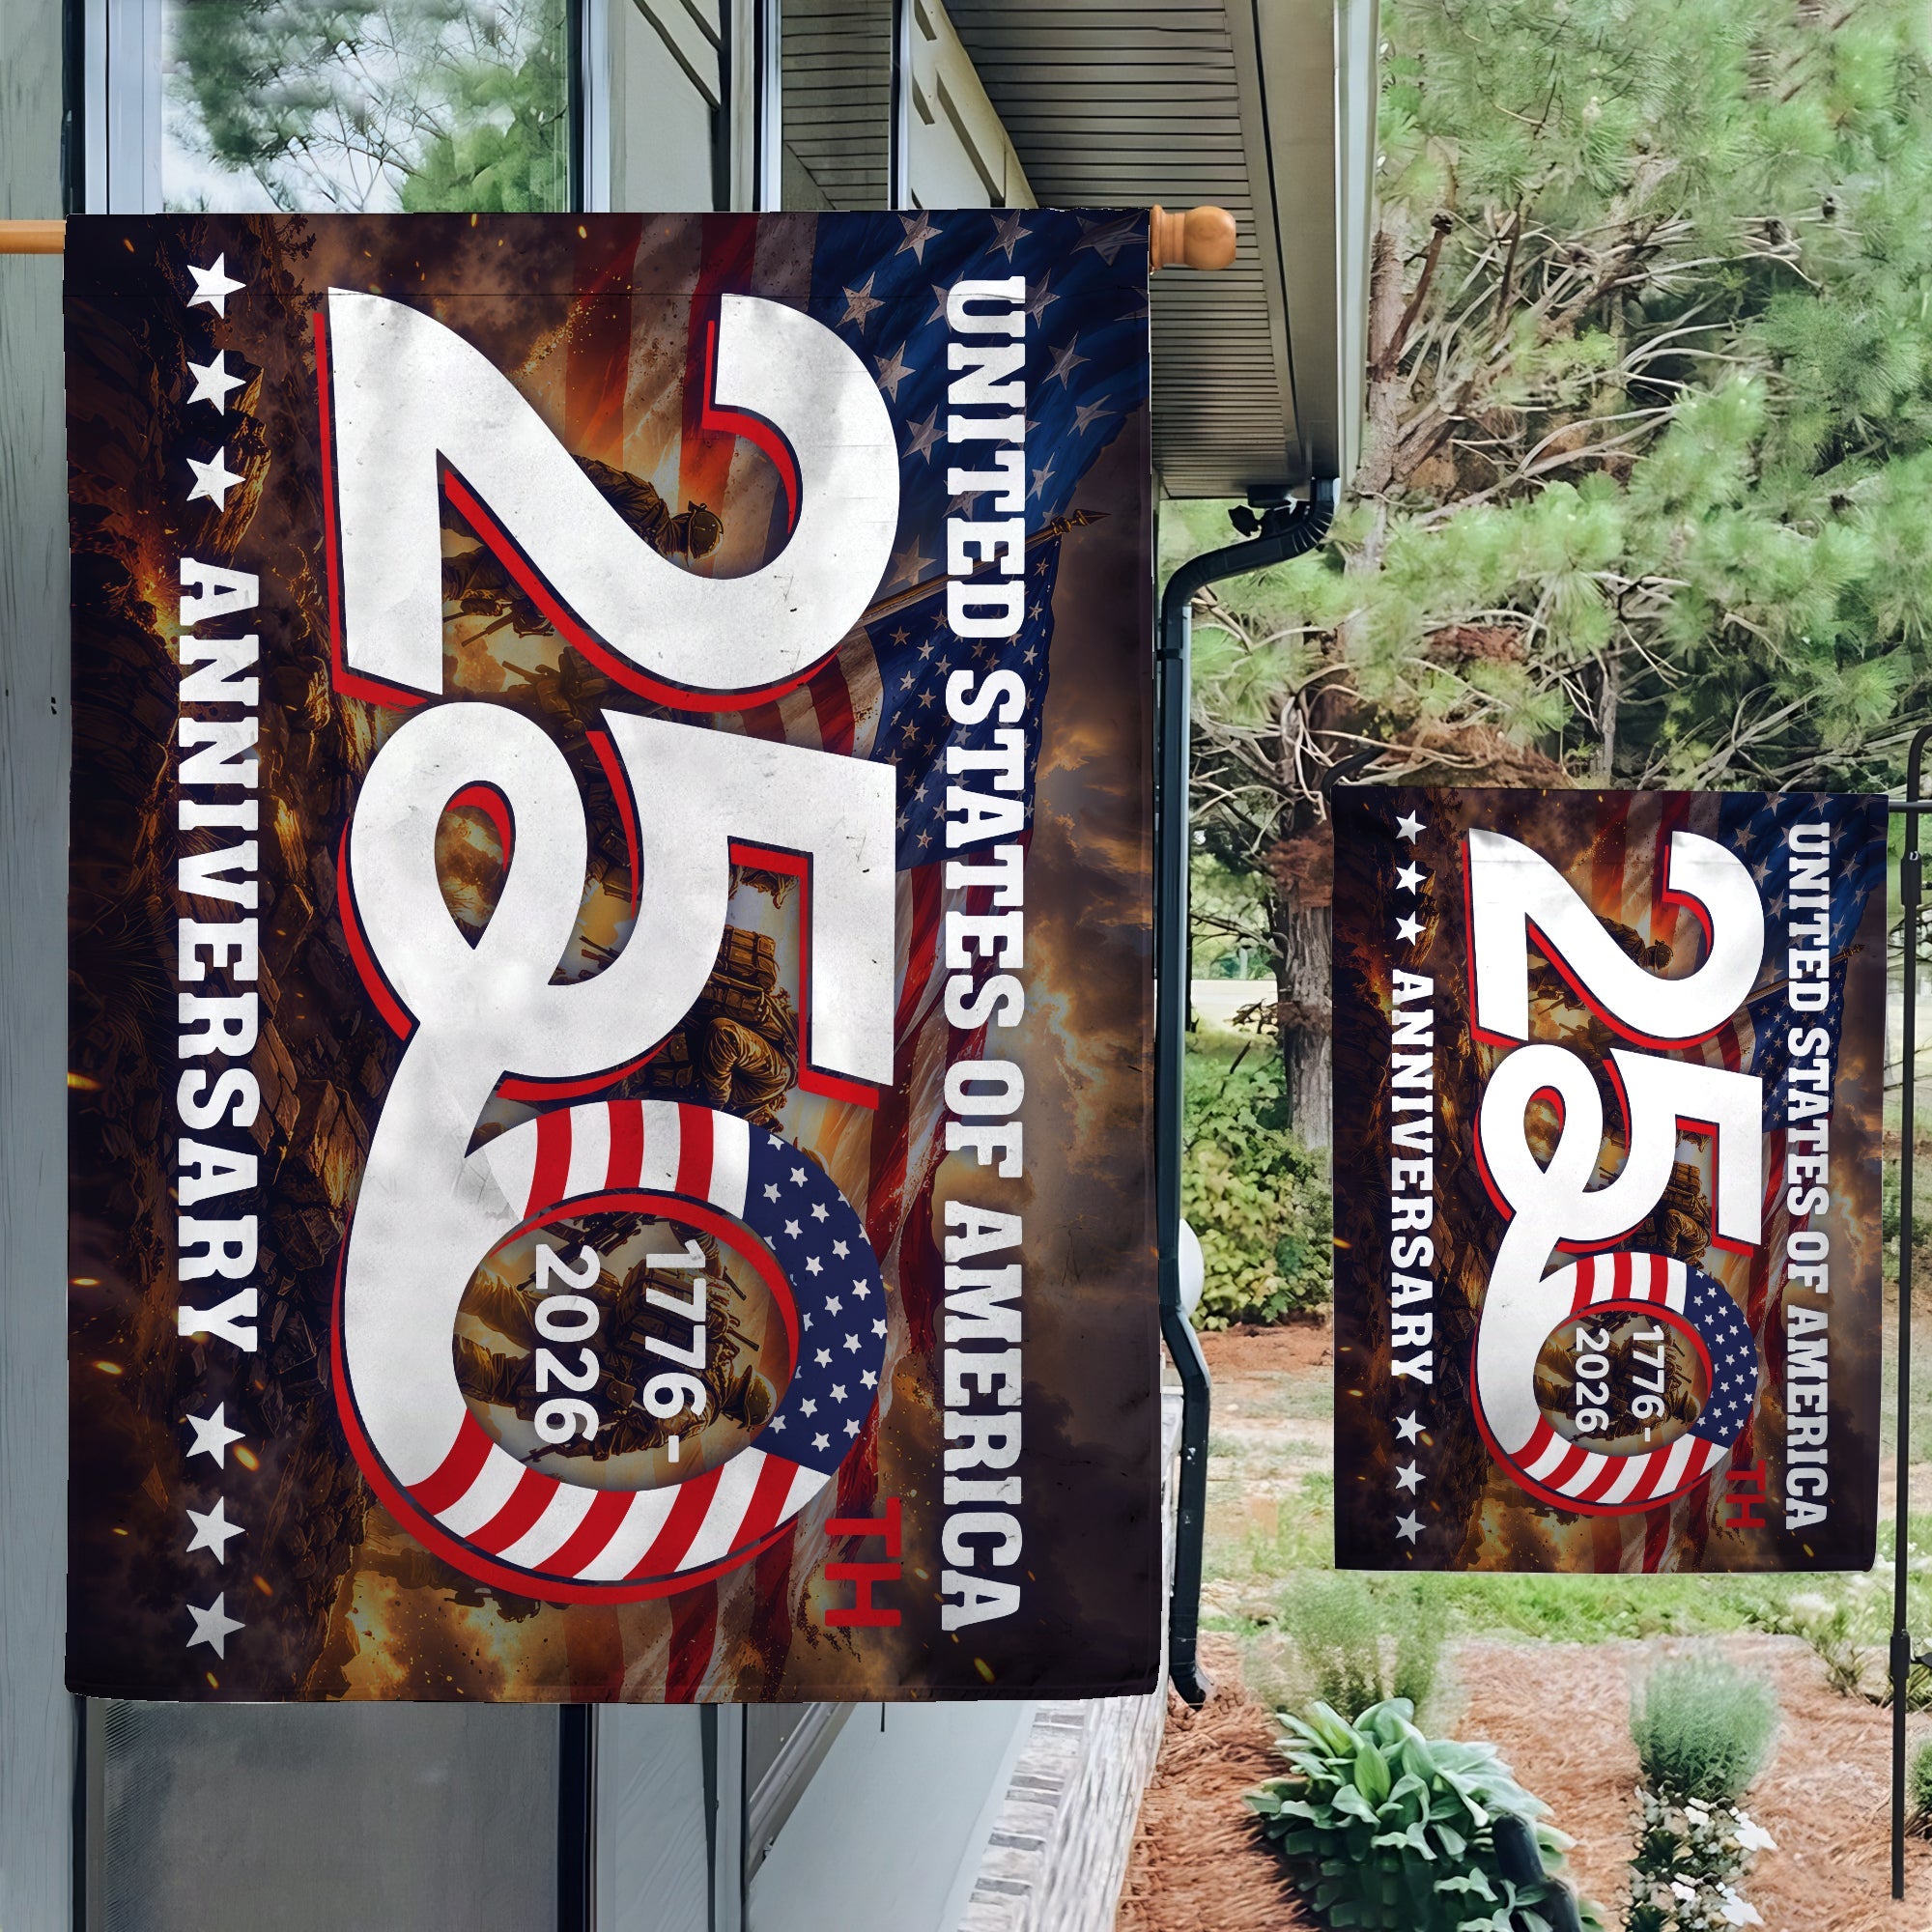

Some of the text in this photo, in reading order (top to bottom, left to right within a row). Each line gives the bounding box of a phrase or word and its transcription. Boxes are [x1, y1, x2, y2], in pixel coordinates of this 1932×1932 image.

[177, 556, 260, 1352] ANNIVERSARY
[317, 287, 903, 1628] 250 TH
[941, 275, 1027, 1632] UNITED STATES OF AMERICA
[1390, 969, 1435, 1384] ANNIVERSARY
[1461, 827, 1767, 1529] 250 TH
[1785, 822, 1831, 1530] UNITED STATES OF AMERICA
[533, 1242, 601, 1446] 2026
[642, 1238, 707, 1463] 1776-
[1575, 1327, 1609, 1434] 2026
[1632, 1324, 1665, 1443] 1776-
